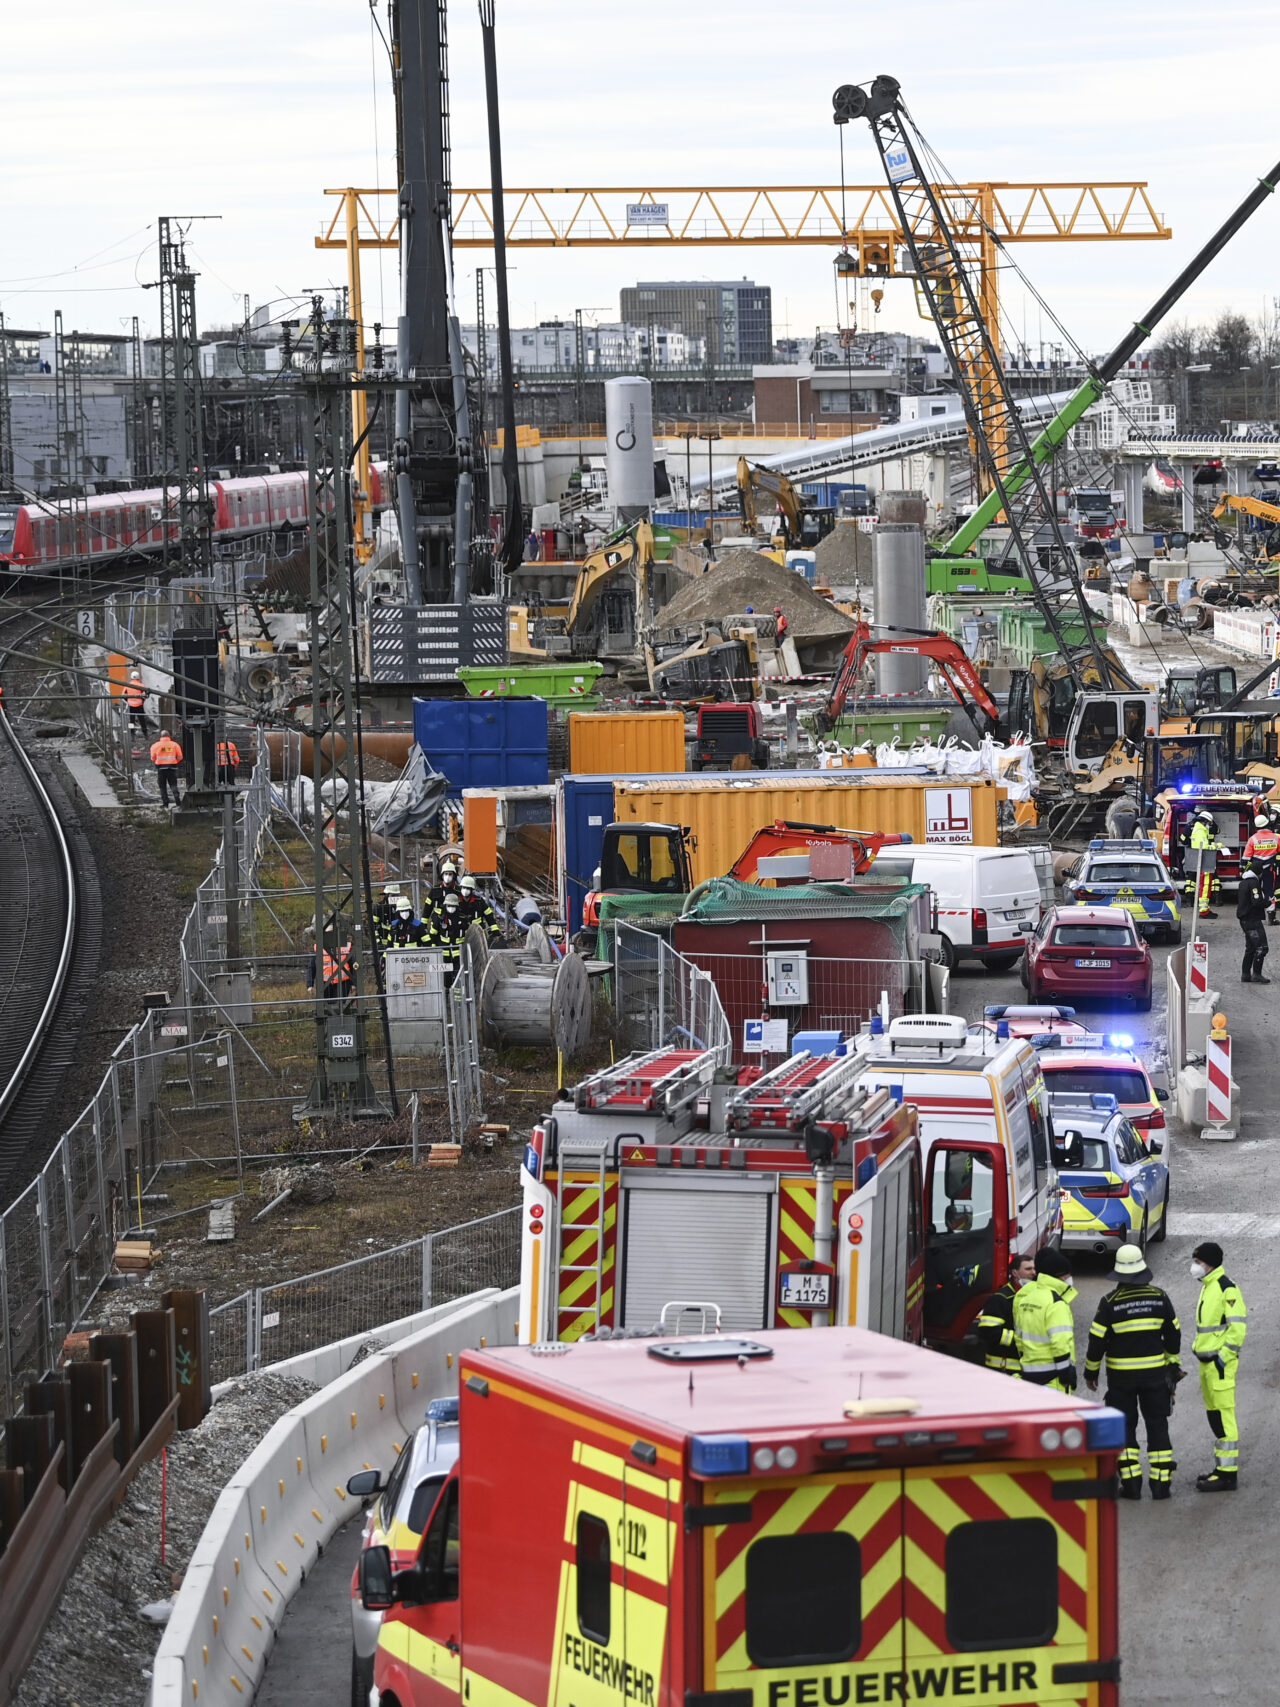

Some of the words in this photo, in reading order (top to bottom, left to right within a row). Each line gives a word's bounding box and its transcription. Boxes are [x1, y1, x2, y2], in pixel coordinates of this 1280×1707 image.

[630, 206, 641, 214] VAN
[82, 612, 91, 625] 2
[417, 626, 459, 634] LIEBHERR
[959, 665, 976, 689] Kubota
[1197, 784, 1247, 793] FEUERWEHR
[926, 836, 946, 844] MAX
[948, 835, 972, 843] BÖGL
[211, 915, 227, 923] MAC
[165, 1027, 187, 1036] MAC
[334, 1037, 352, 1046] S342
[803, 1276, 812, 1289] M
[783, 1288, 792, 1301] F
[795, 1289, 826, 1303] 1175
[627, 1519, 648, 1561] 112
[564, 1632, 656, 1707] FEUERWEHR
[767, 1661, 1039, 1707] FEUERWEHR
